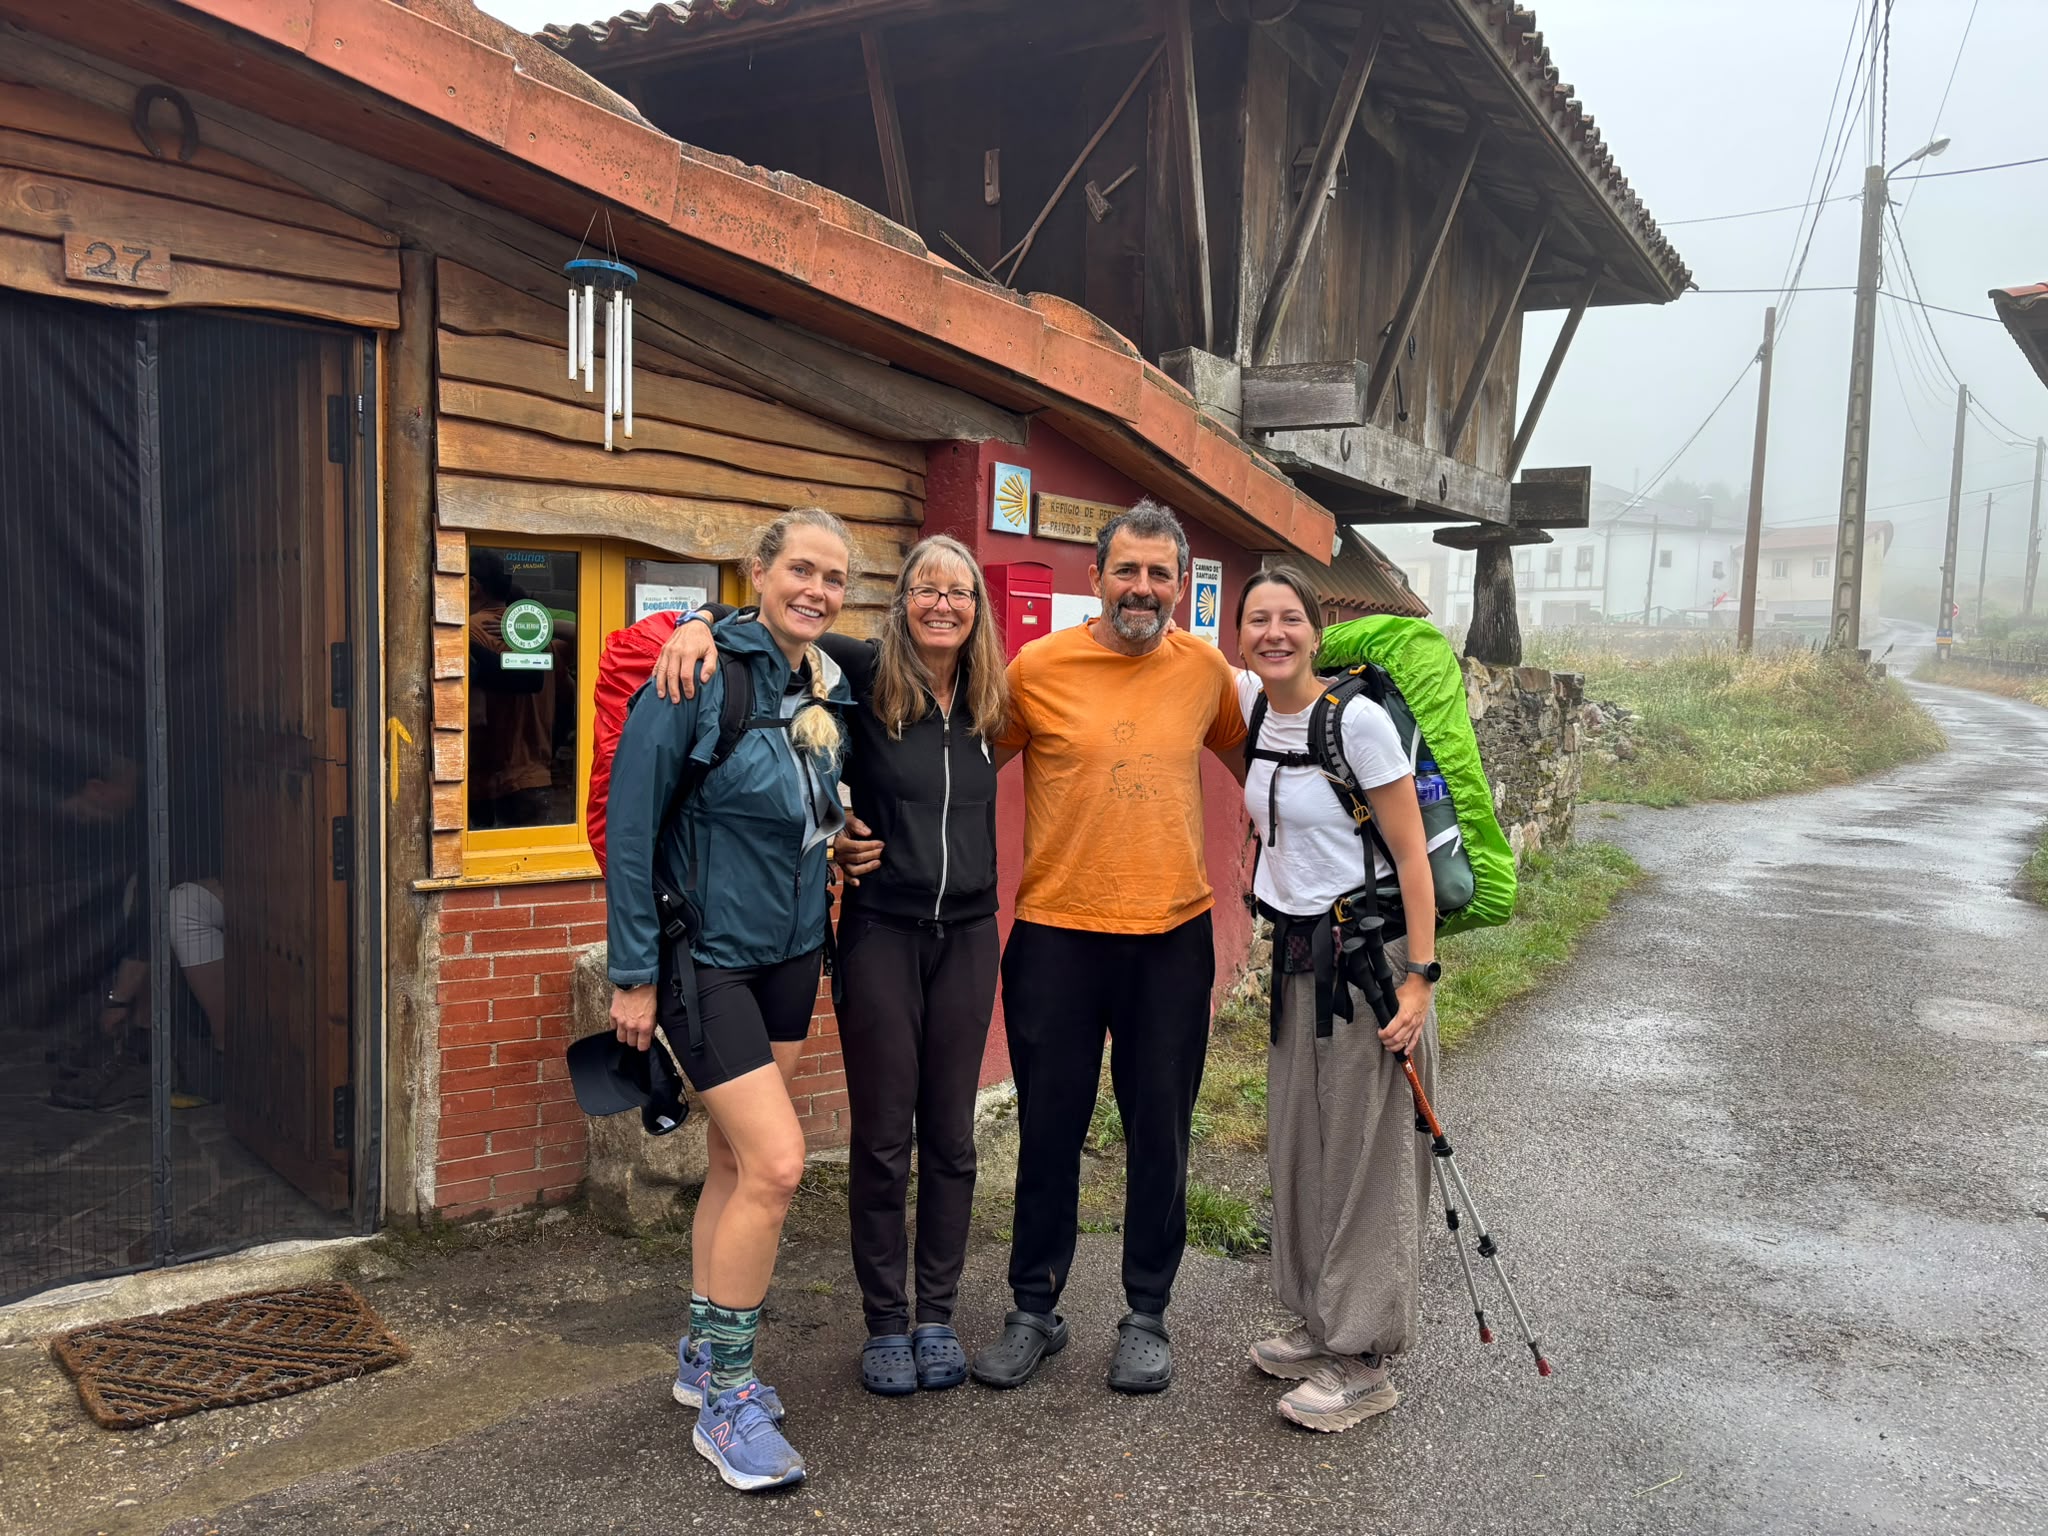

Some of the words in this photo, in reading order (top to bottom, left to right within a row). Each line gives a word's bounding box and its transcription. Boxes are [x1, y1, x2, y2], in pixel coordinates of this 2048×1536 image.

[85, 241, 151, 282] 27
[1050, 502, 1080, 515] REFUGIO
[1084, 507, 1094, 518] DE
[1083, 526, 1092, 536] DE
[1195, 563, 1212, 572] CAMINO
[1213, 565, 1219, 573] DE
[1196, 571, 1218, 580] SANTIAGO
